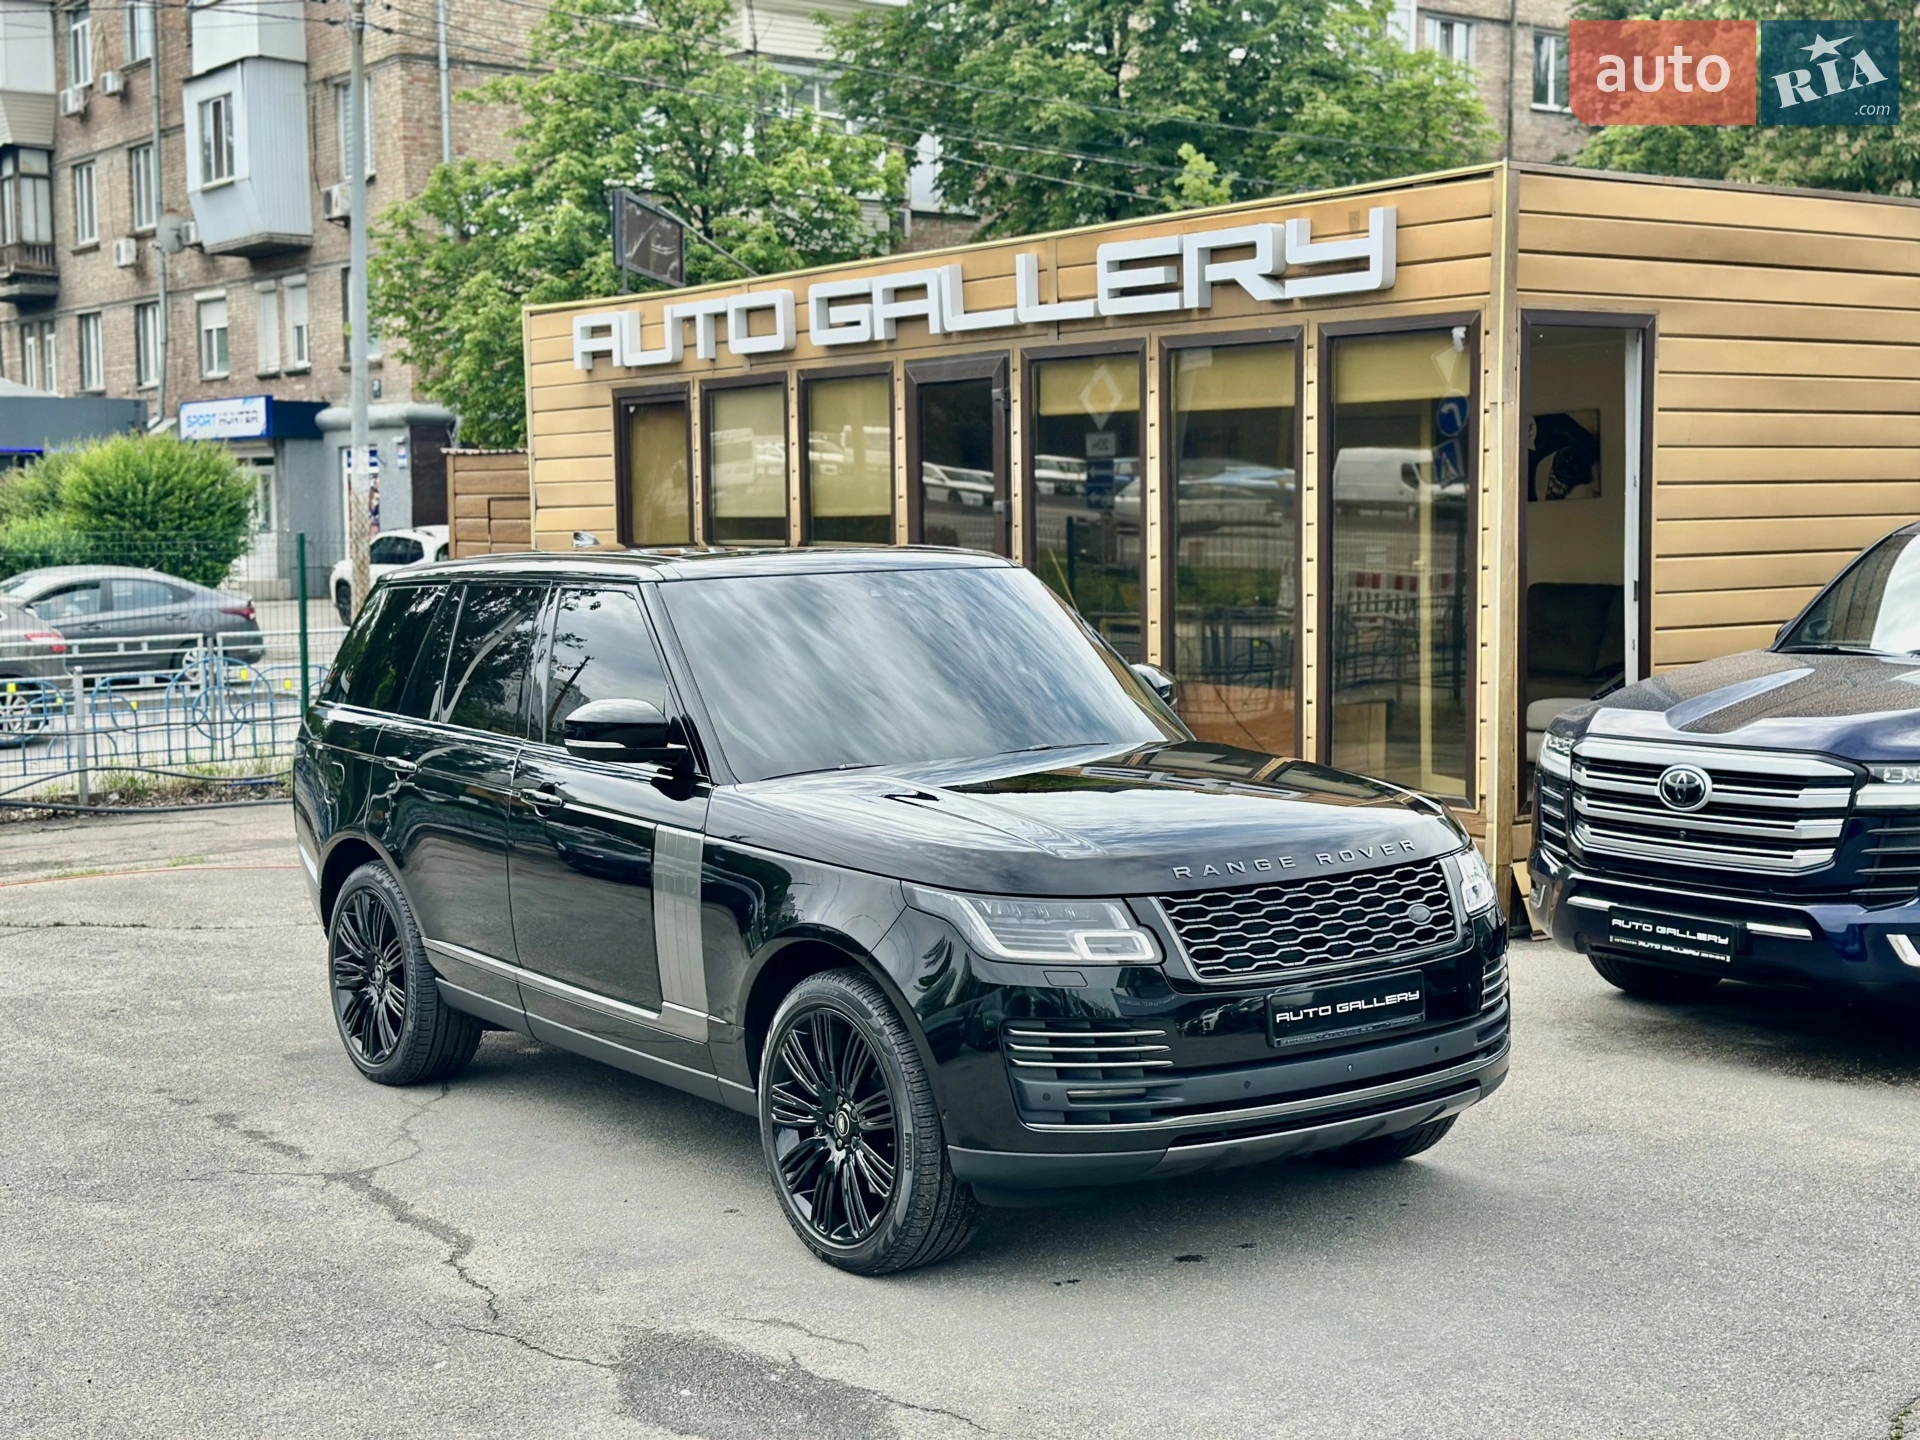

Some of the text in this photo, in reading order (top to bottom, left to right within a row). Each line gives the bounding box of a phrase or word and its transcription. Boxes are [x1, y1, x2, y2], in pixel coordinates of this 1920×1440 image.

[572, 206, 1397, 371] AUTO GALLERY
[186, 412, 217, 429] SPORT
[1172, 838, 1417, 880] RANGE ROVER
[1611, 918, 1653, 932] AUTO
[1655, 925, 1729, 945] GALLERY
[1275, 990, 1420, 1024] AUTO GALLERY
